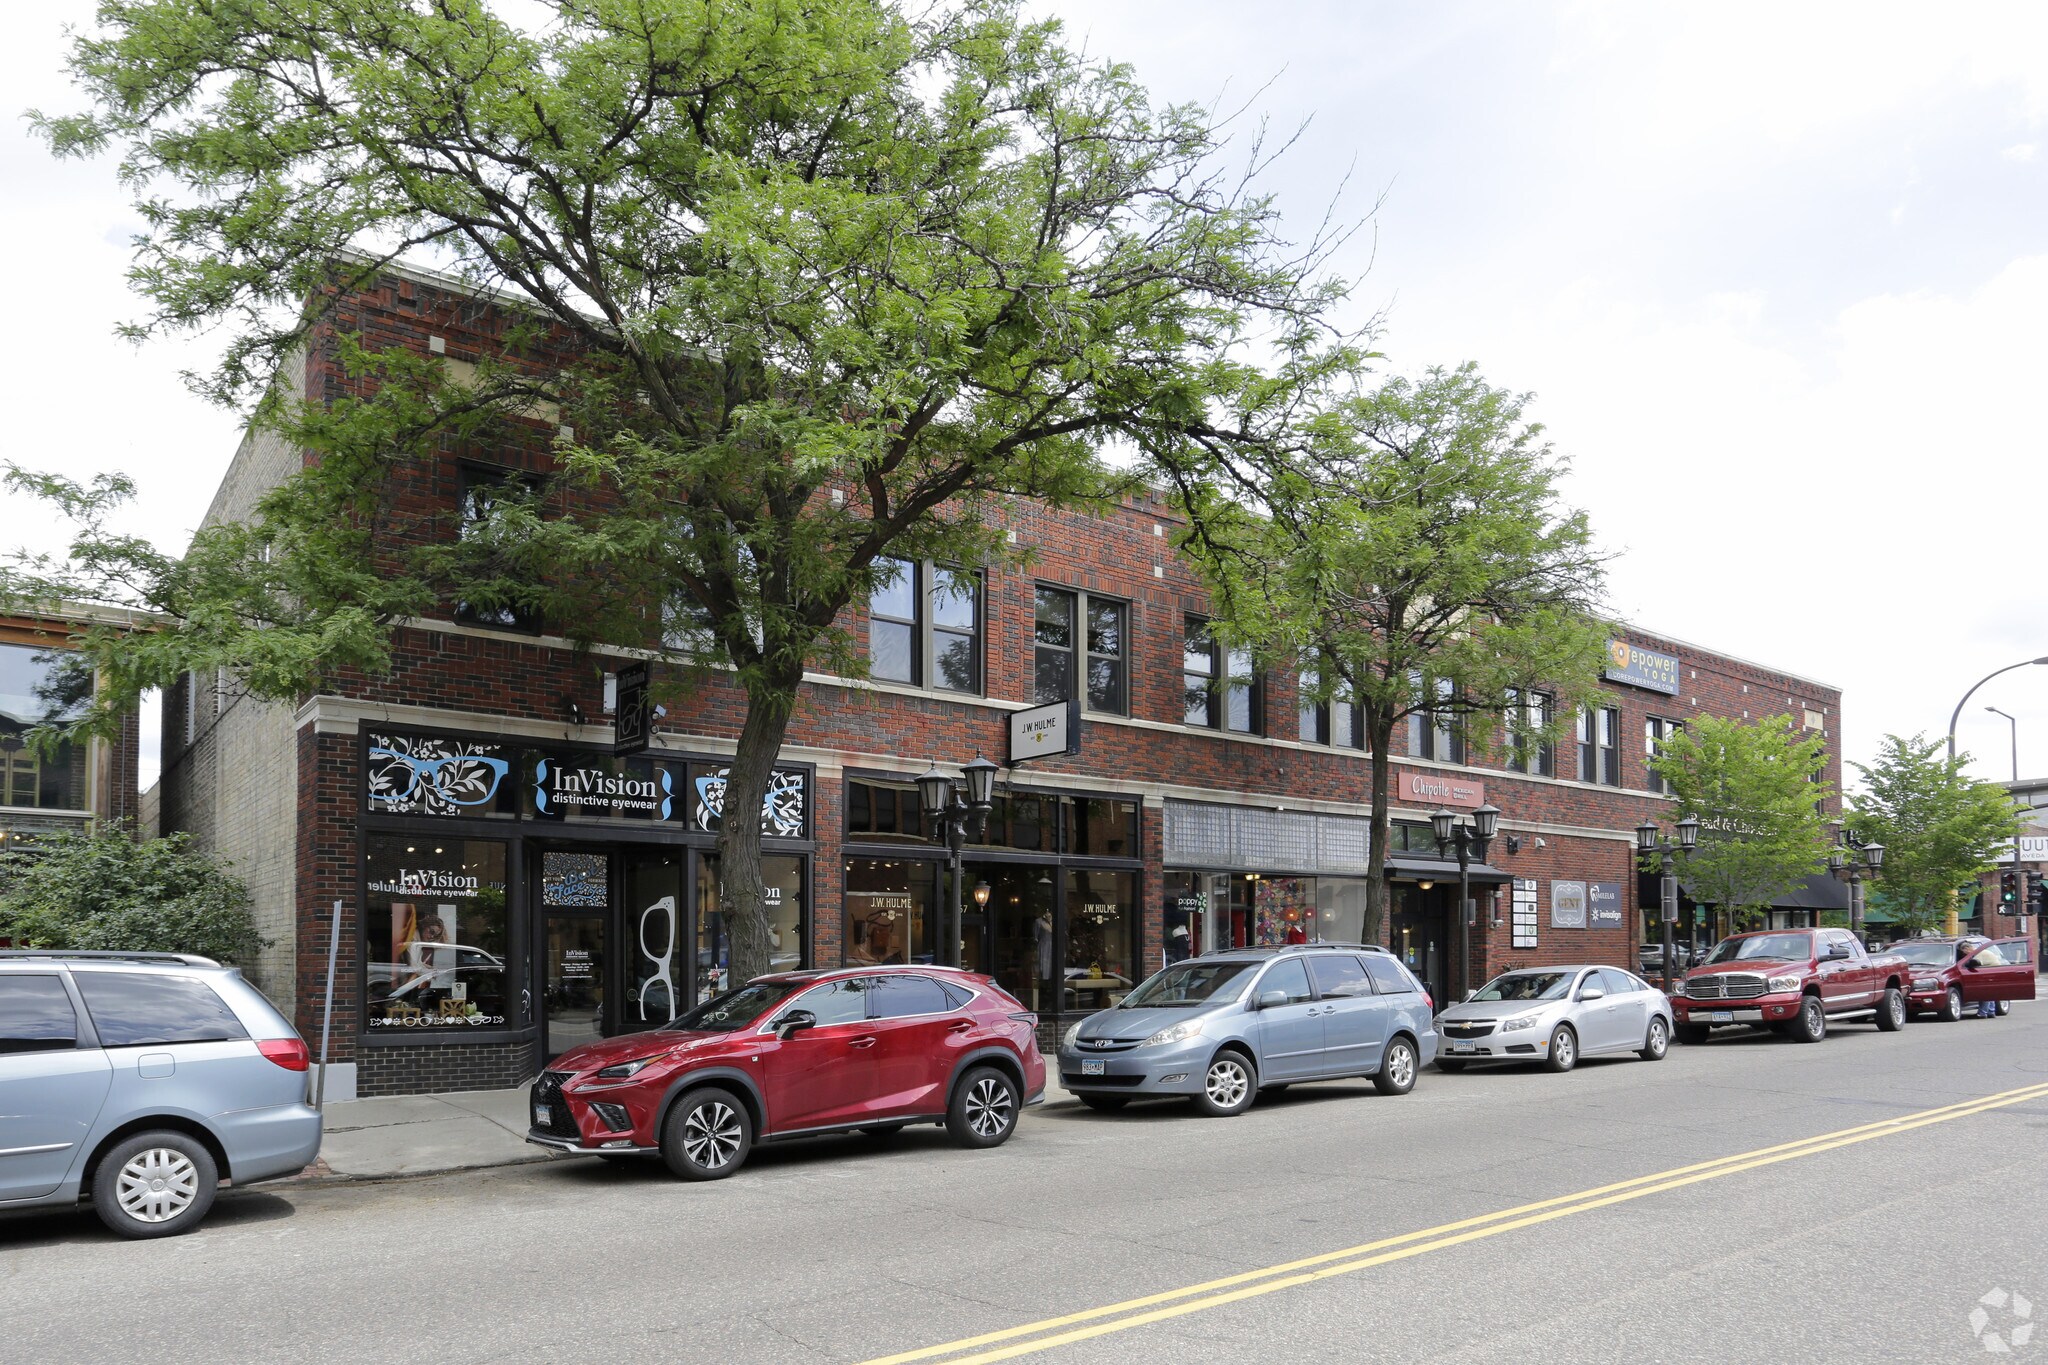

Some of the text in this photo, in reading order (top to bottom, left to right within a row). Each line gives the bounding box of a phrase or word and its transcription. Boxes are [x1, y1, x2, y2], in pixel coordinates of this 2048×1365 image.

[1612, 671, 1674, 692] COREPOWERYOGA.COM
[1643, 667, 1676, 684] YOGA
[1034, 717, 1056, 731] HULME
[553, 766, 657, 798] InVision
[1412, 776, 1474, 800] Chipotle MEXICAN
[553, 793, 657, 809] distinctive eyewear
[1453, 792, 1467, 800] GRILL
[399, 868, 478, 888] InVision
[399, 887, 478, 898] distinctive eyewear
[871, 898, 912, 909] J.W. HULME
[1083, 904, 1116, 914] J.W. HULME
[1178, 898, 1198, 907] poppy
[1558, 897, 1582, 909] GENT
[1600, 909, 1622, 921] invisalign
